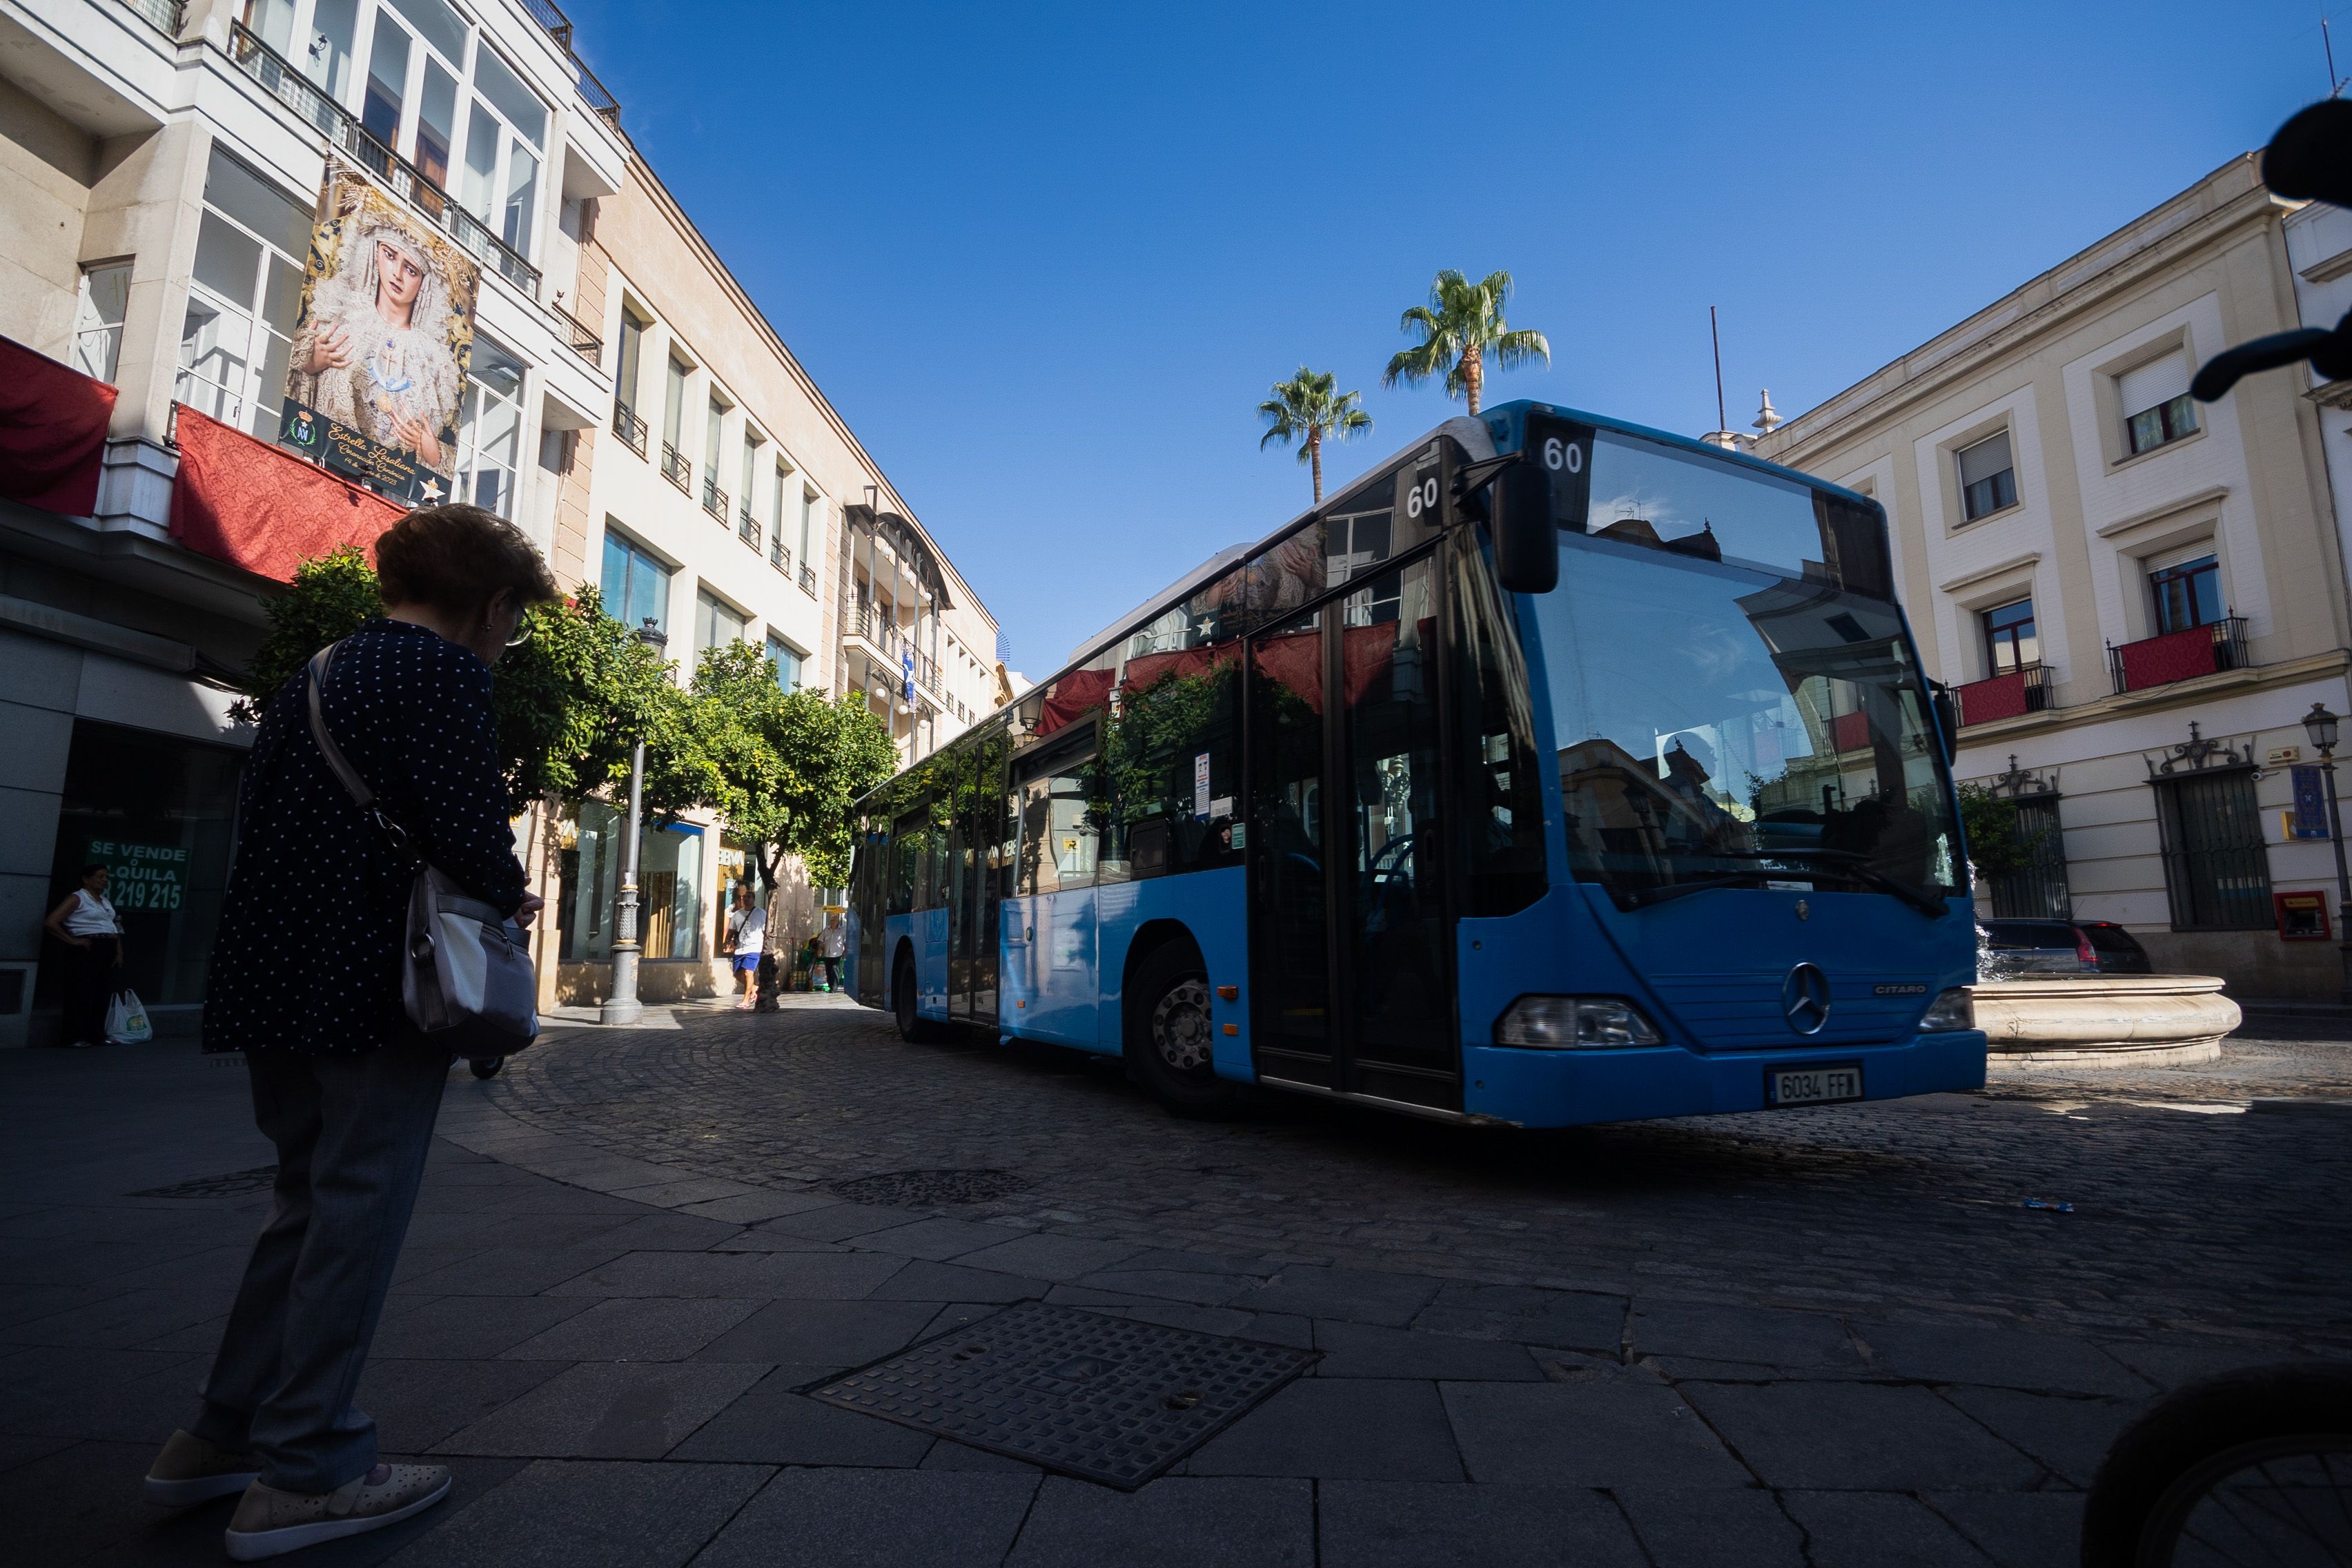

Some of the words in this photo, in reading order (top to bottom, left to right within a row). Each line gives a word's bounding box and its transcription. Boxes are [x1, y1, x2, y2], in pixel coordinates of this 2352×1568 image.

[328, 423, 367, 451] Estrella
[1544, 438, 1582, 473] 60
[1407, 478, 1438, 518] 60
[90, 841, 115, 855] SE
[121, 844, 186, 861] VENDE
[106, 865, 177, 882] LQUILA
[114, 881, 146, 908] 219
[149, 883, 182, 909] 215
[1874, 985, 1927, 995] CITARO
[1781, 1074, 1822, 1099] 6034
